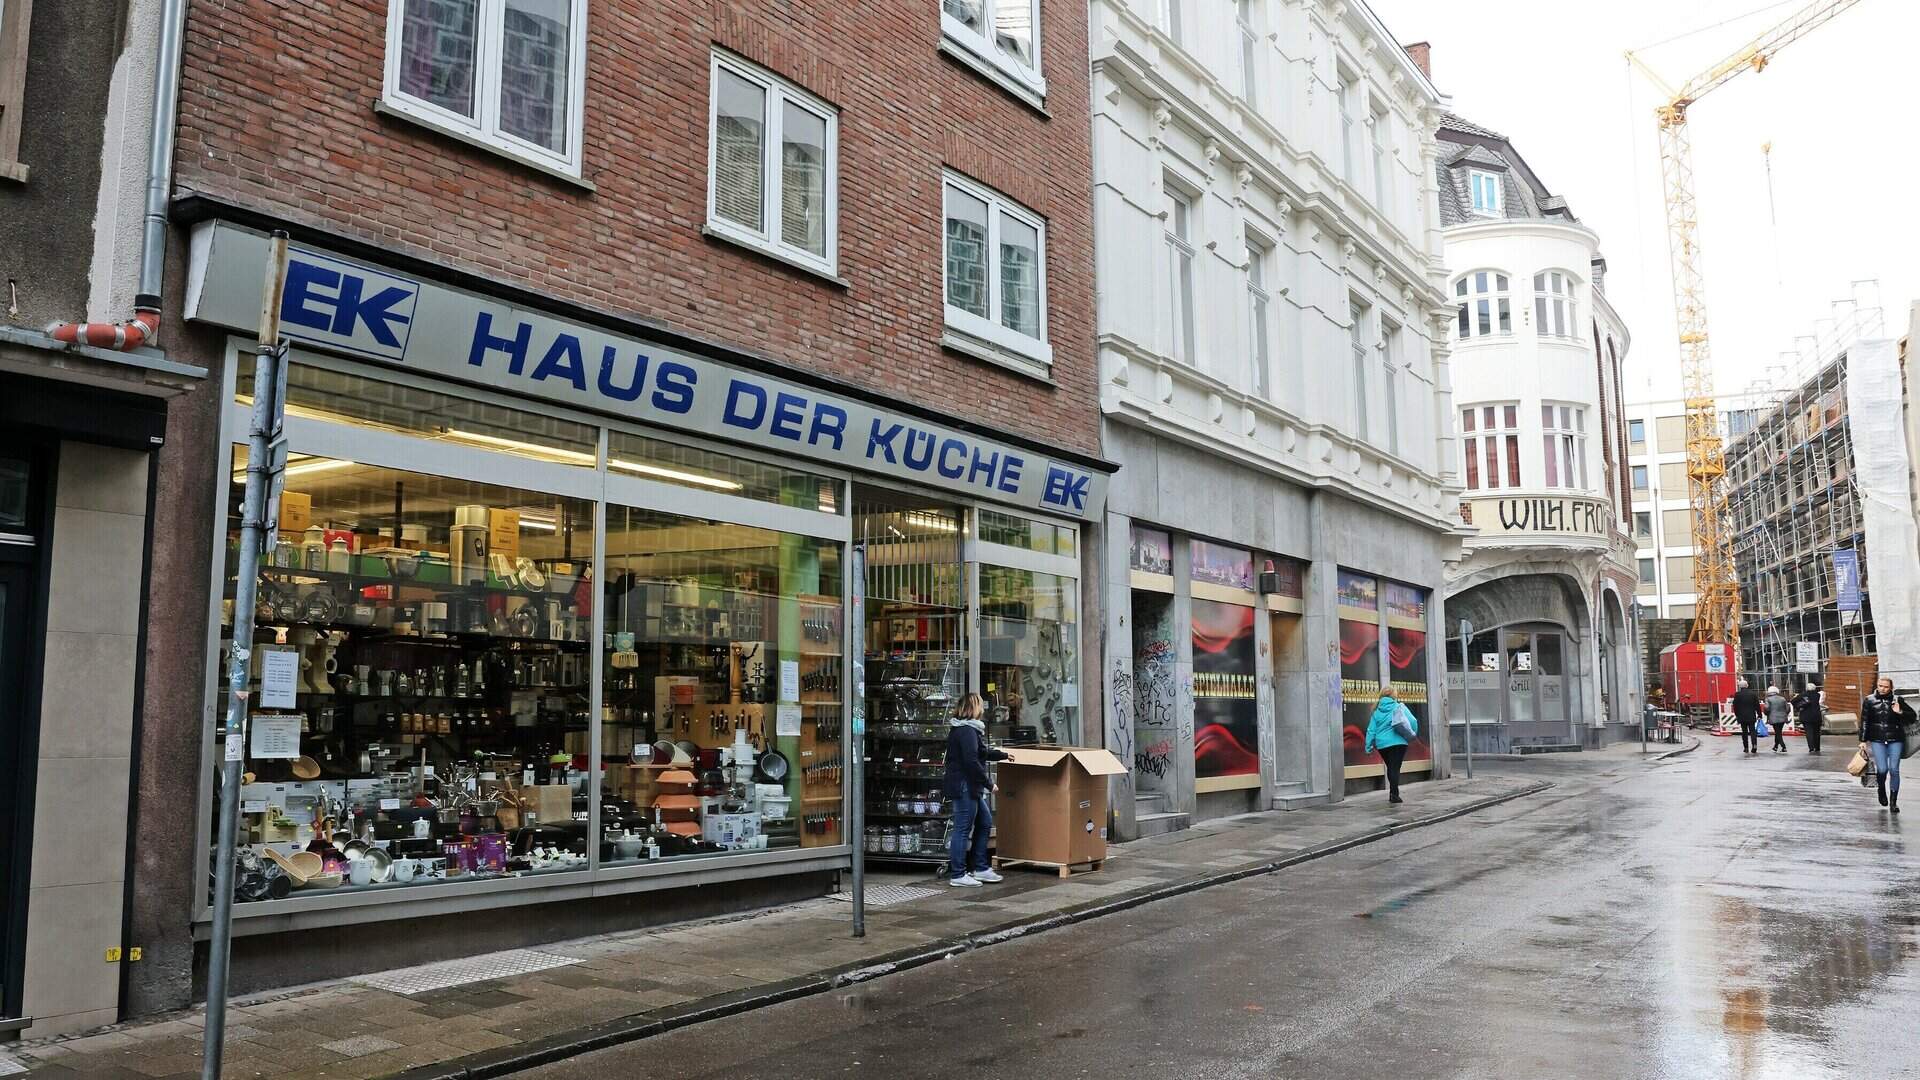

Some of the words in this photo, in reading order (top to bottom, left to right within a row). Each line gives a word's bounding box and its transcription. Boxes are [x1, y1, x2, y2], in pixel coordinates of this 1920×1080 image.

[280, 260, 413, 347] EK
[469, 312, 697, 413] HAUS
[722, 379, 848, 450] DER
[866, 417, 1025, 494] KÜCHE
[1045, 467, 1090, 510] EK
[1510, 678, 1530, 692] Grill
